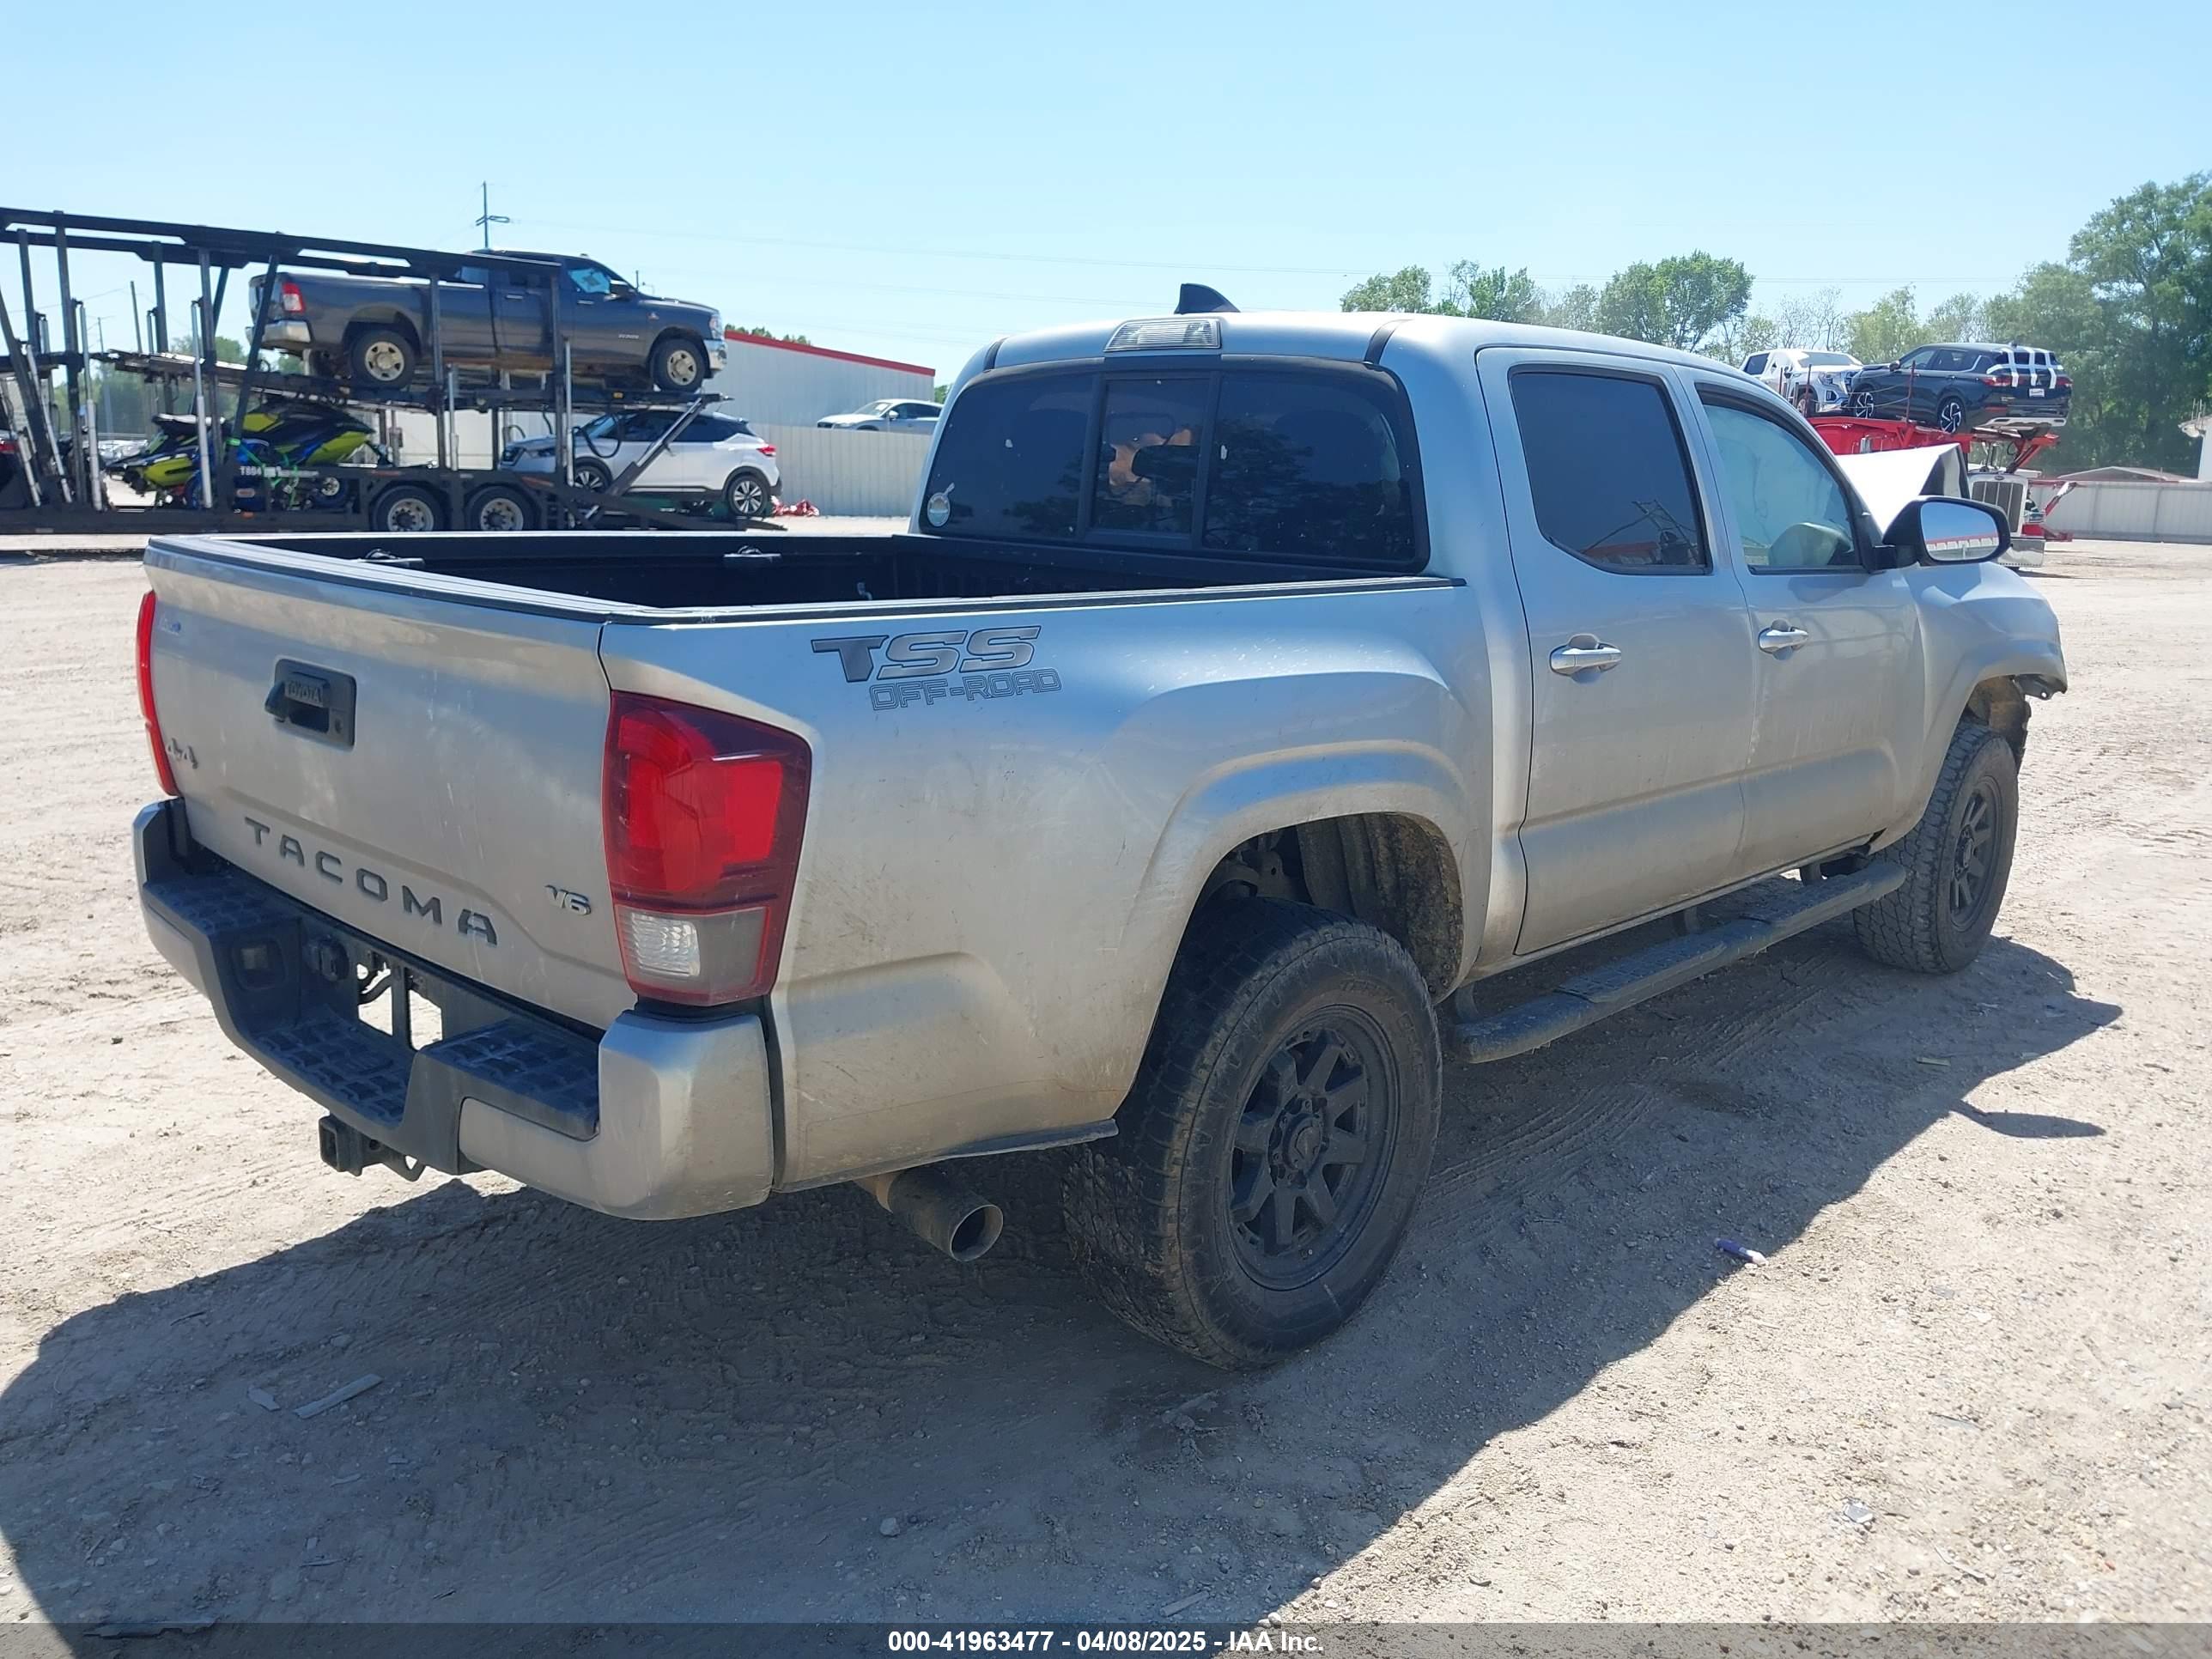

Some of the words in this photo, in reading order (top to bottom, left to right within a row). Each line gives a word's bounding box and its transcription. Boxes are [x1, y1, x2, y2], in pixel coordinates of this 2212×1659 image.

[811, 625, 1041, 683] TSS
[287, 681, 323, 703] TOYOTA
[869, 669, 1062, 711] OFF-ROAD
[245, 817, 497, 946] TACOMA
[544, 884, 592, 915] V6
